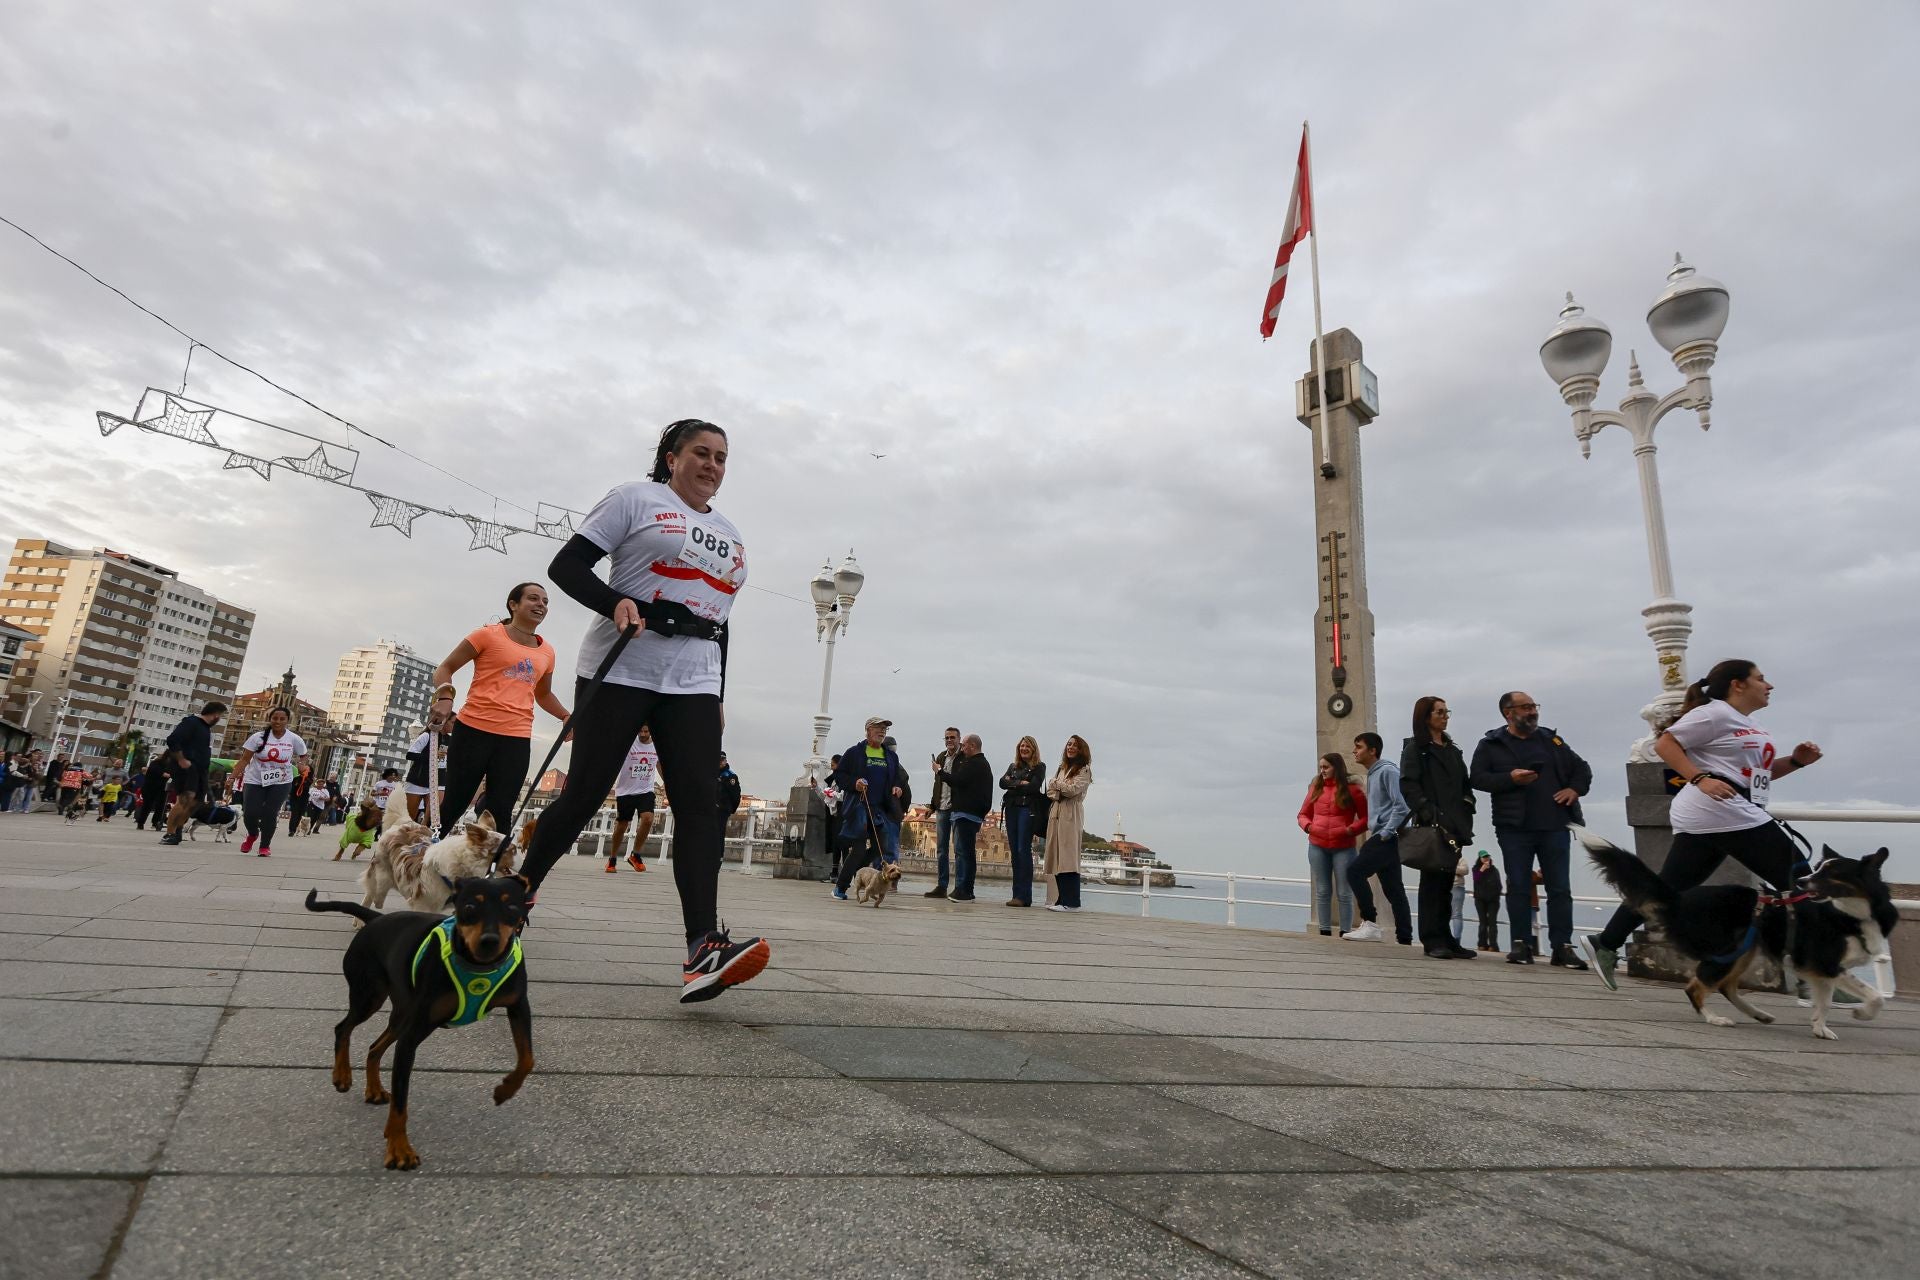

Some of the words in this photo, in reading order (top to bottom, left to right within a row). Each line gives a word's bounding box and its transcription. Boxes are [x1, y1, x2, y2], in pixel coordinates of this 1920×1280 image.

[691, 526, 730, 559] 088
[633, 765, 647, 773] 234
[263, 771, 280, 781] 026
[1753, 774, 1770, 791] 09
